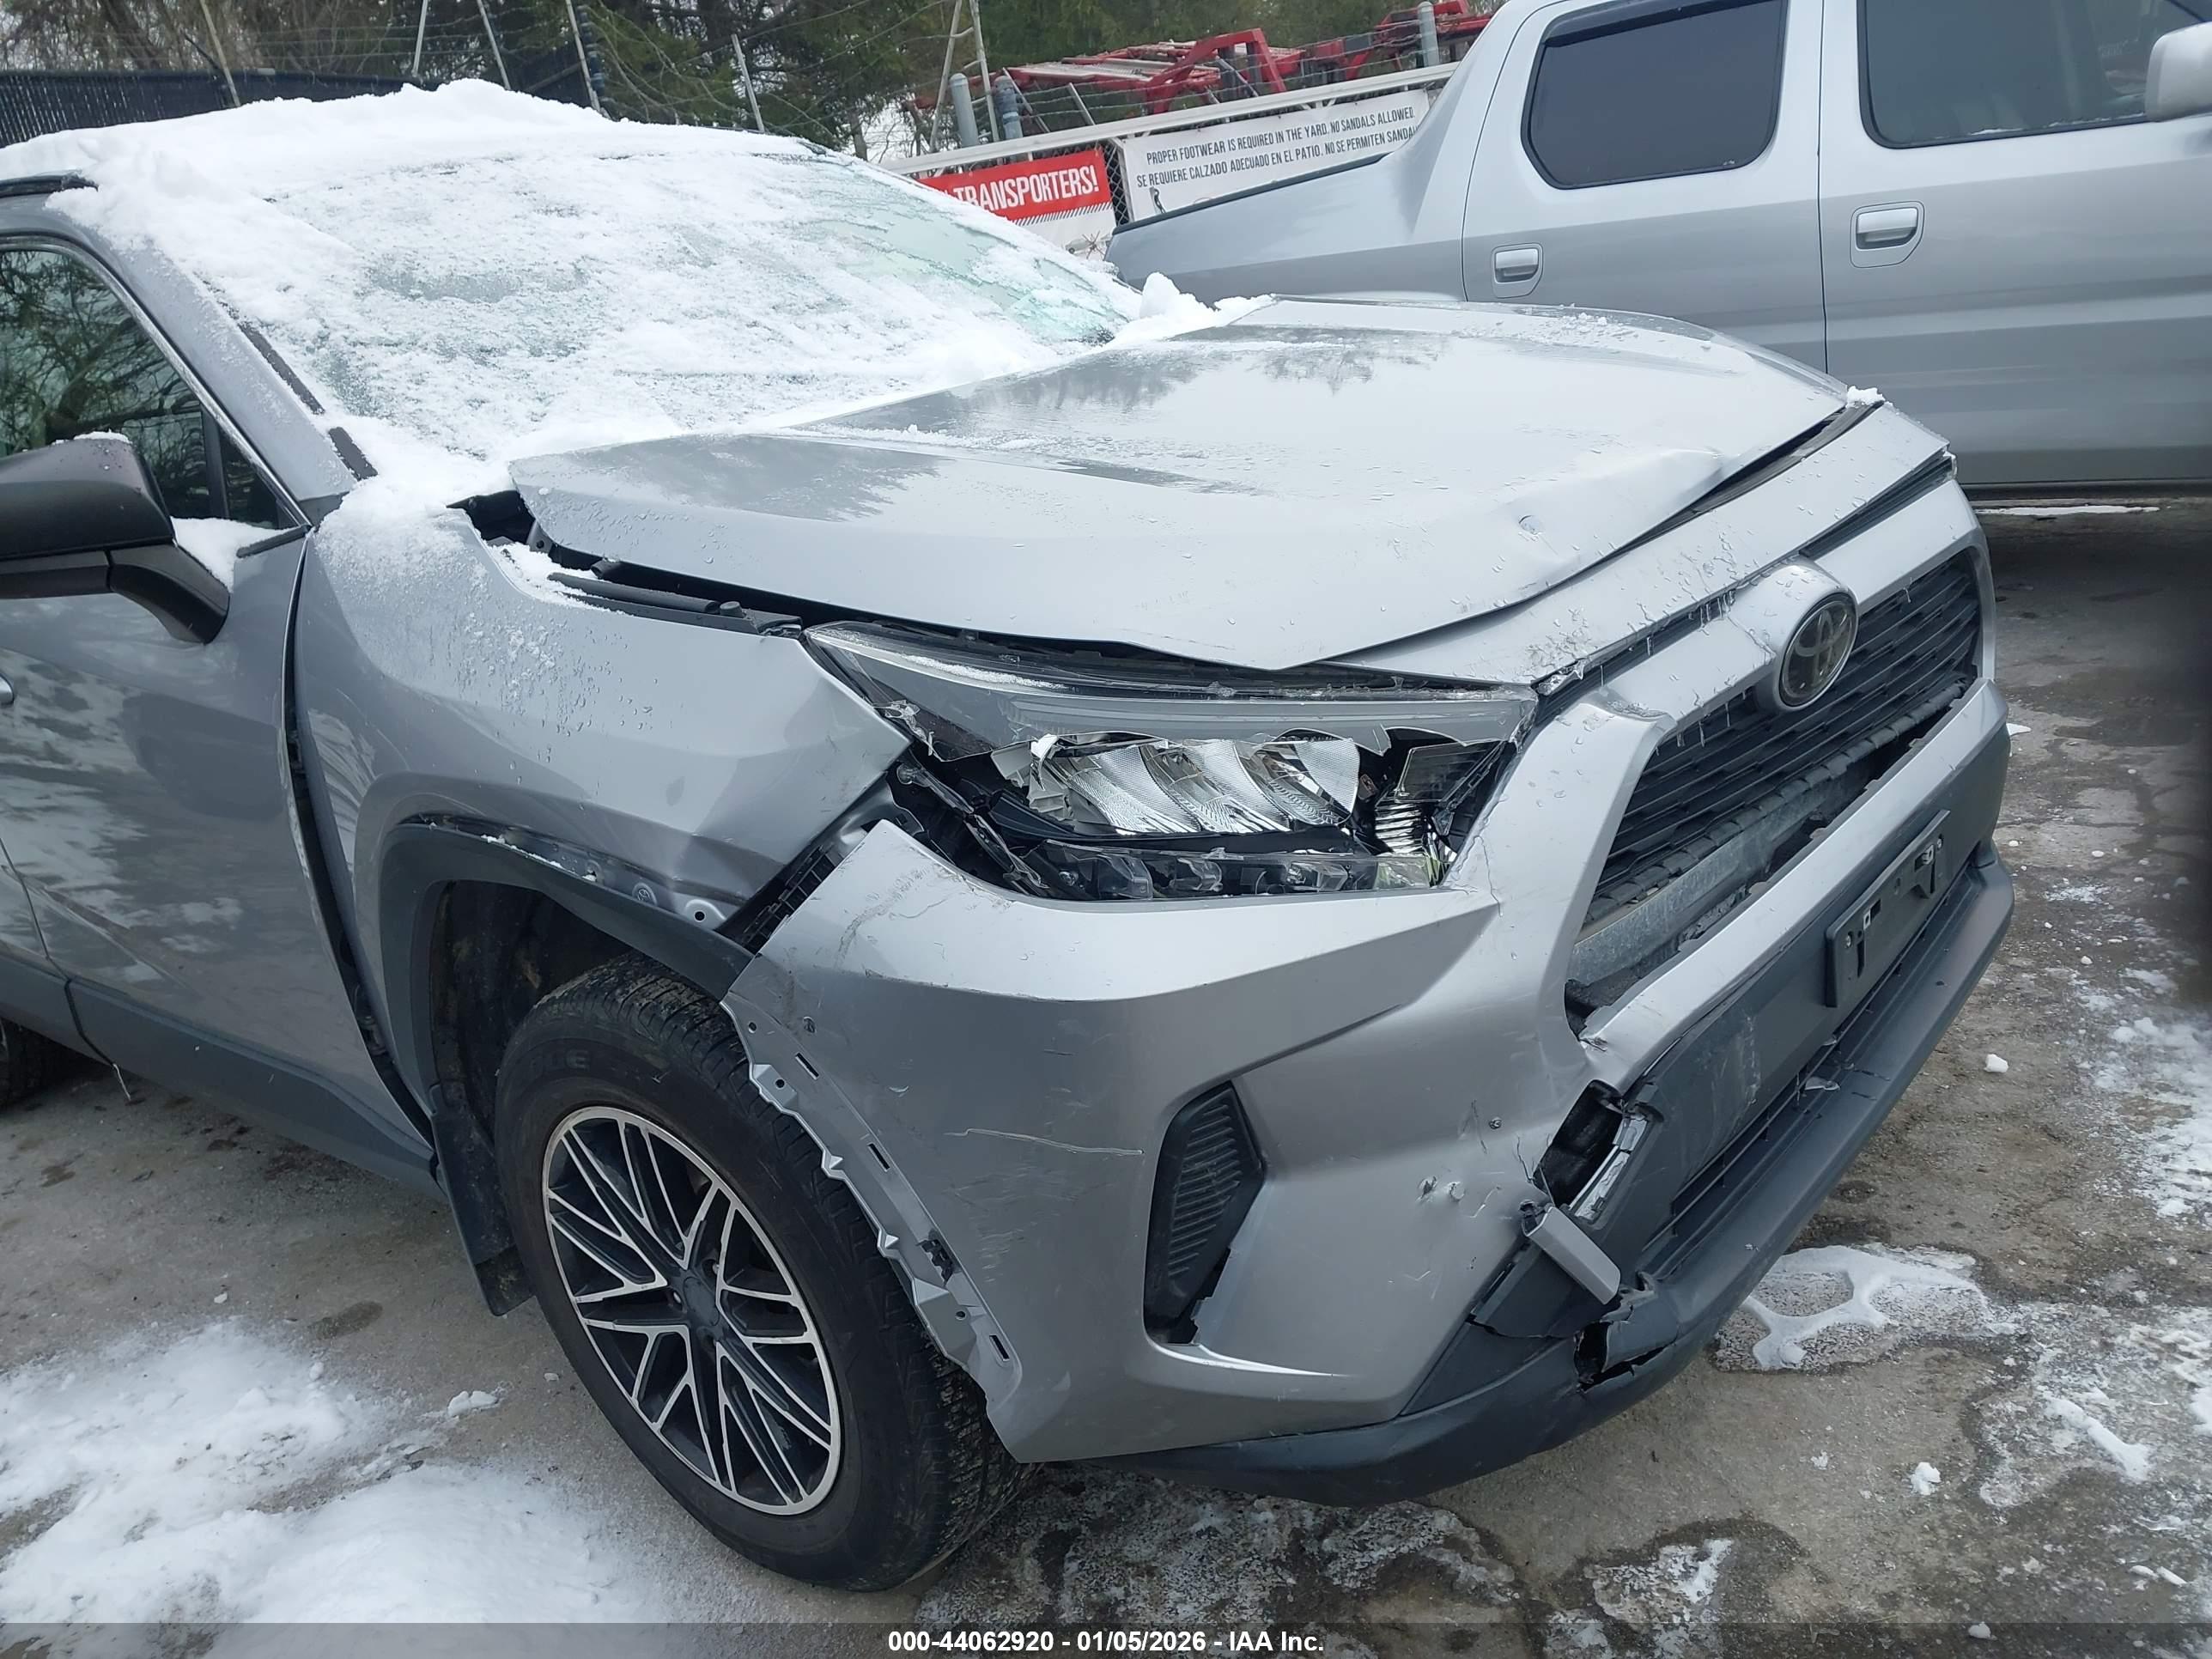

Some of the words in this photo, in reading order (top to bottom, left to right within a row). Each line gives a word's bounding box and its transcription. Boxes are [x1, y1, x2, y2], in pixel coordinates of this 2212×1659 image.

[1137, 175, 1148, 187] SE
[1149, 168, 1188, 186] REQUIERE
[1189, 161, 1228, 179] CALZADO
[1231, 155, 1270, 173] ADECUADO
[1271, 153, 1282, 166] EN
[1284, 150, 1294, 162] EL
[1295, 144, 1323, 161] PATIO.
[1325, 141, 1335, 155] NO
[1336, 140, 1346, 153] SE
[1346, 133, 1386, 151] PERMITEN
[1146, 149, 1178, 166] PROPER
[1180, 142, 1225, 161] FOOTWEAR
[1227, 139, 1237, 151] IS
[1237, 133, 1274, 150] REQUIRED
[1275, 131, 1285, 143] IN
[1285, 126, 1303, 142] THE
[1304, 123, 1330, 138] YARD.
[1330, 120, 1340, 134] NO
[1340, 113, 1376, 131] SANDALS
[1377, 106, 1416, 125] ALLOWED.
[952, 164, 1100, 212] TRANSPORTERS!
